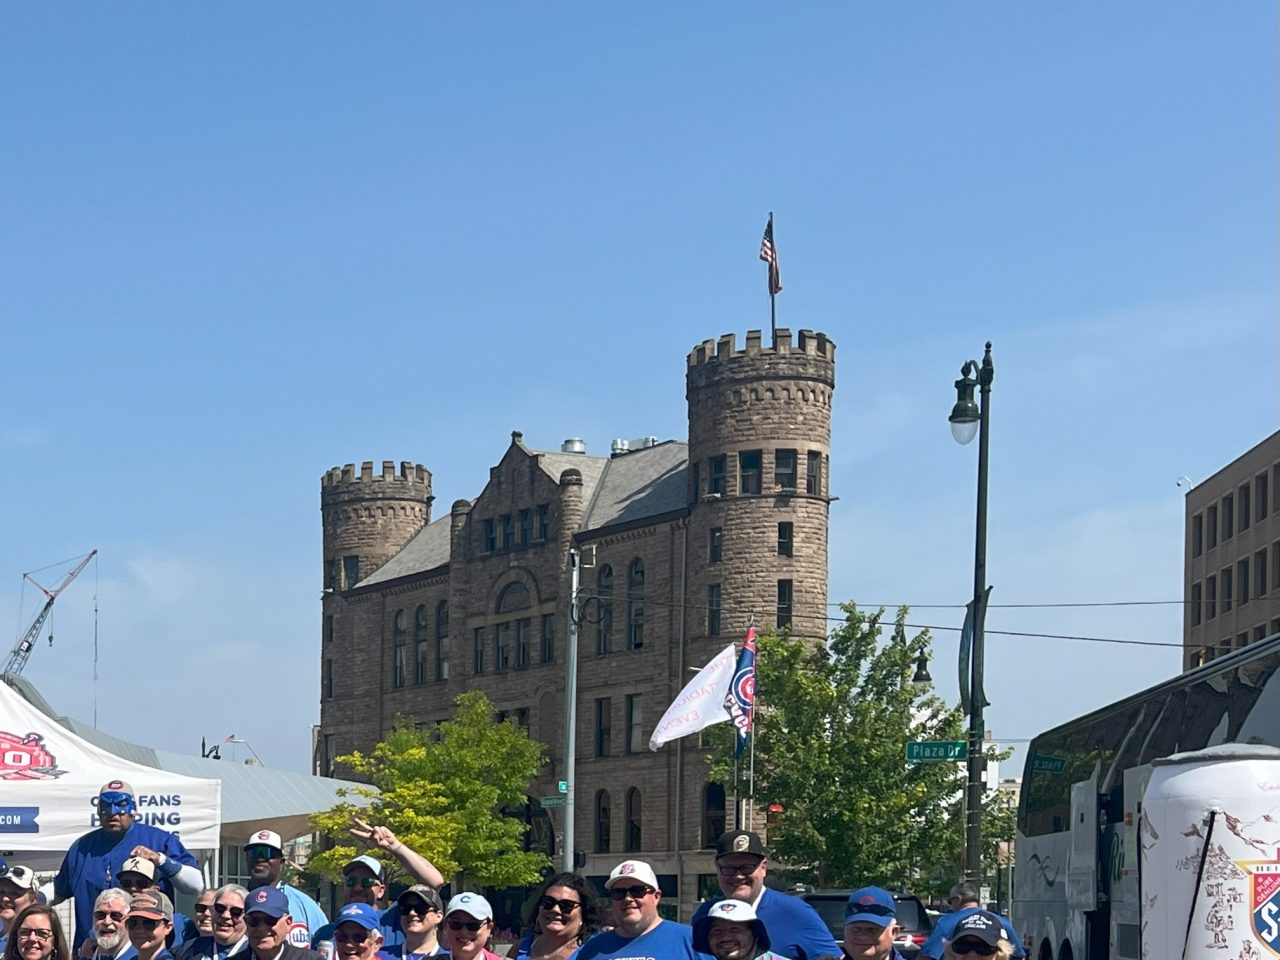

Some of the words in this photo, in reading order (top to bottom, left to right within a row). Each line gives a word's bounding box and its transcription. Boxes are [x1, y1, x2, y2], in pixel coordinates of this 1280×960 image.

[913, 745, 945, 758] Plaza
[947, 744, 961, 757] Dr
[138, 794, 182, 807] FANS
[90, 811, 182, 828] HPING
